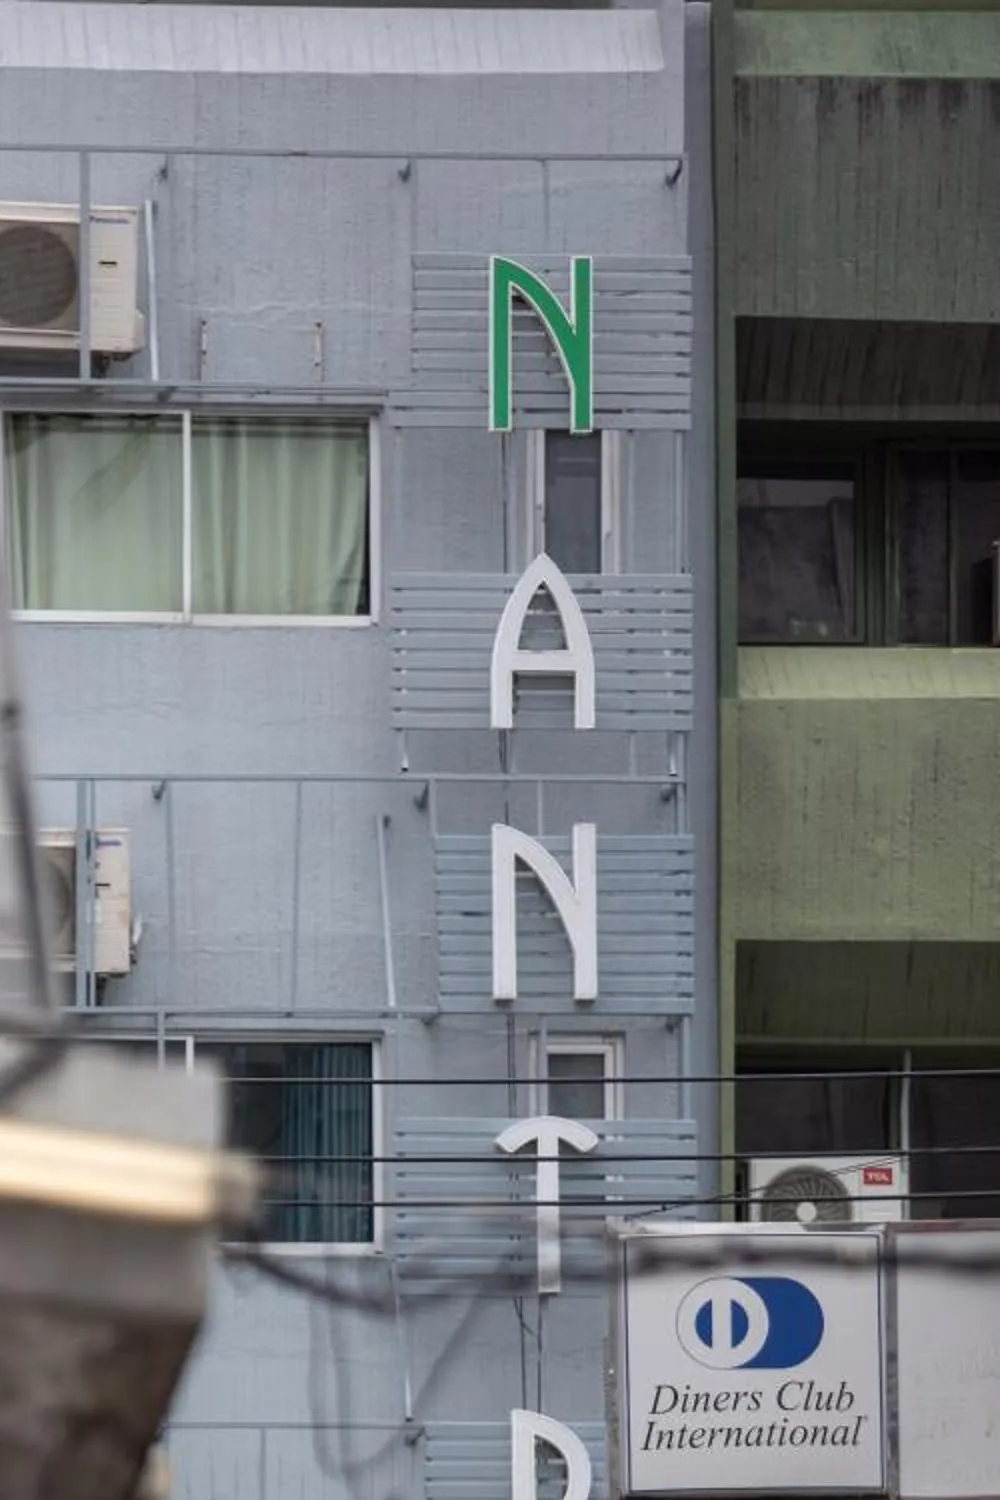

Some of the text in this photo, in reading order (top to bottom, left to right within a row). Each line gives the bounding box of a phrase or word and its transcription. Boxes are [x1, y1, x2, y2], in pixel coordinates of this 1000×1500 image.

[649, 1380, 855, 1415] Diners Club
[642, 1415, 864, 1451] International
